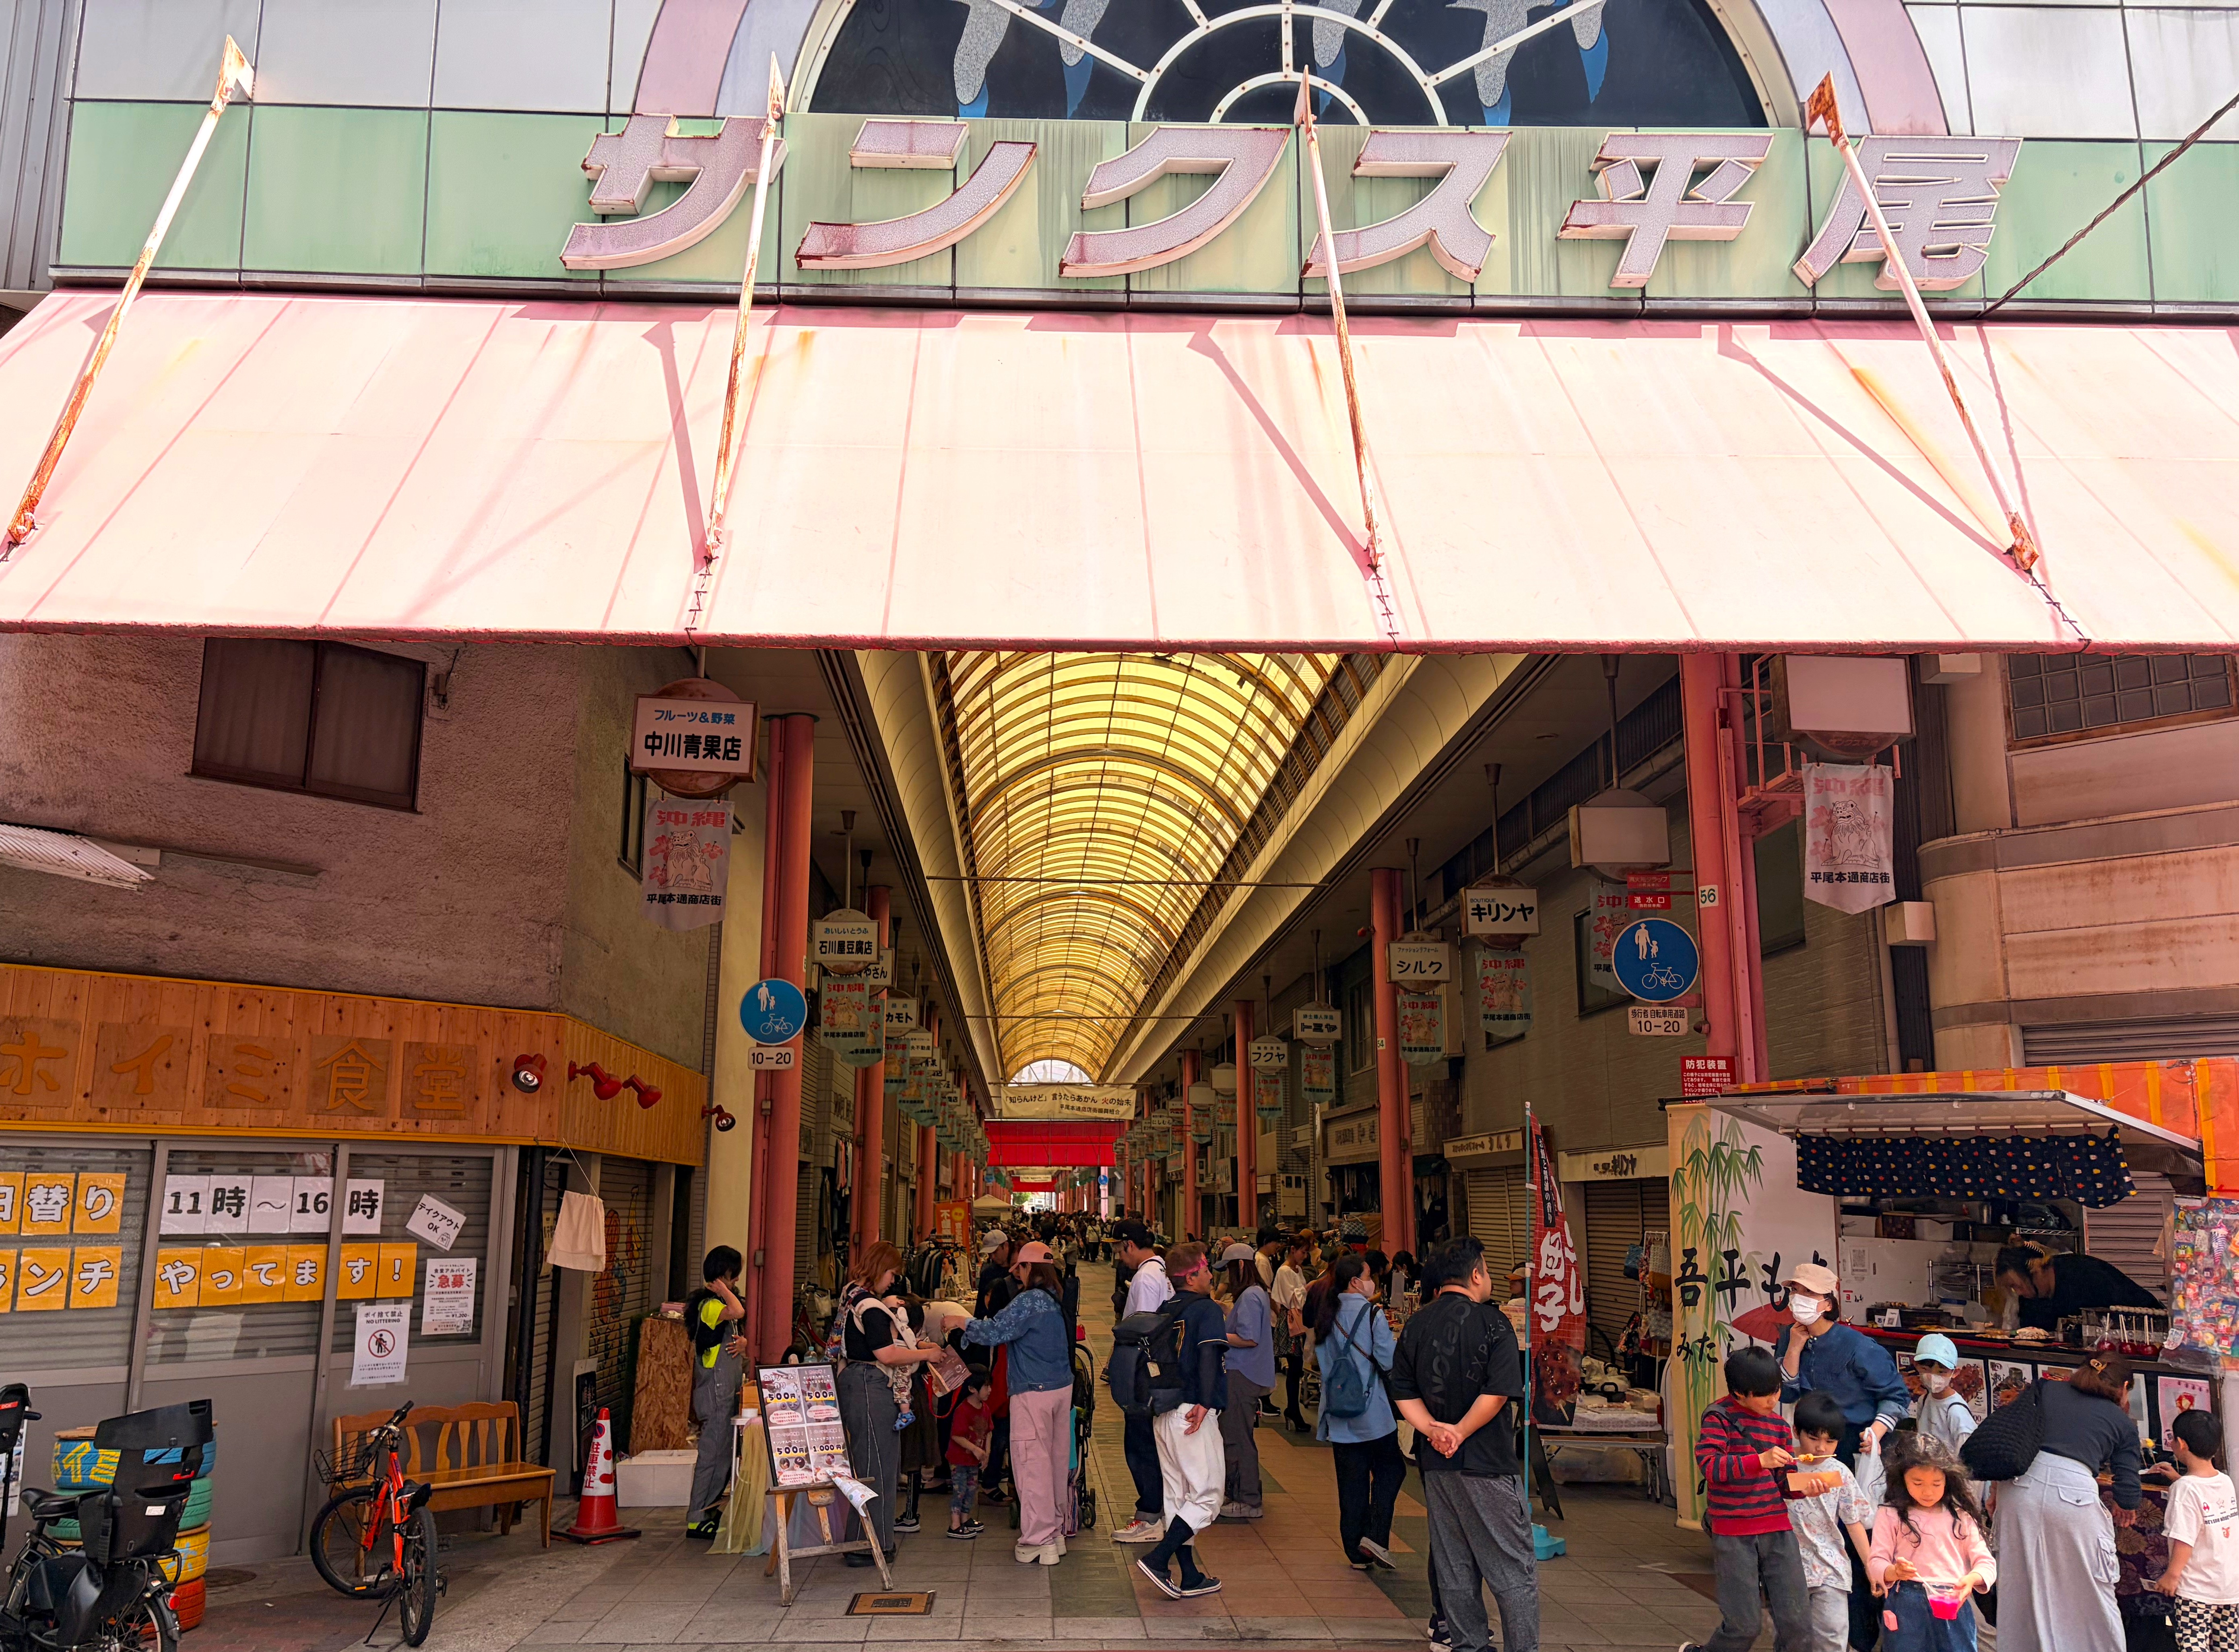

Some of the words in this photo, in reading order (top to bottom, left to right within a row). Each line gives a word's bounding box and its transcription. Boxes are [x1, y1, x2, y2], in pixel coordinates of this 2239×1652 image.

[559, 113, 2022, 291] サンクス平尾
[644, 731, 742, 761] 中川青果店
[1813, 777, 1884, 796] 沖縄
[656, 809, 726, 828] 沖縄
[1810, 871, 1890, 883] 平尾本通商店街
[646, 893, 722, 905] 平尾本通商店街
[1597, 894, 1628, 909] 沖
[1699, 888, 1716, 904] 56
[1470, 903, 1535, 922] キリンヤ
[819, 940, 873, 955] 石川屋豆腐店
[1396, 960, 1442, 974] シルク
[1482, 958, 1525, 969] 沖縄
[827, 983, 865, 994] 沖縄
[1402, 1000, 1438, 1010] 沖縄
[885, 1012, 913, 1024] カモト
[1631, 1009, 1648, 1018] 歩行者
[1650, 1009, 1685, 1019] 自転車用道路
[1300, 1022, 1338, 1033] トミヤ
[1638, 1020, 1680, 1033] 10-20
[751, 1052, 791, 1064] 10-20
[1251, 1052, 1286, 1063] フクヤ
[1686, 1059, 1727, 1070] 防犯装置
[1005, 1094, 1047, 1104] 「知らんけど」
[1051, 1092, 1098, 1103] 言うたらあかん
[1102, 1097, 1132, 1107] 火の始末
[418, 1202, 460, 1231] テイクアウト
[427, 1222, 440, 1234] OK
[0, 1260, 113, 1296] ンチ
[437, 1274, 465, 1288] 急募
[768, 1392, 796, 1401] 500円
[807, 1391, 834, 1399] 500円
[776, 1446, 804, 1455] 500円
[584, 1442, 601, 1489] 駐車禁止
